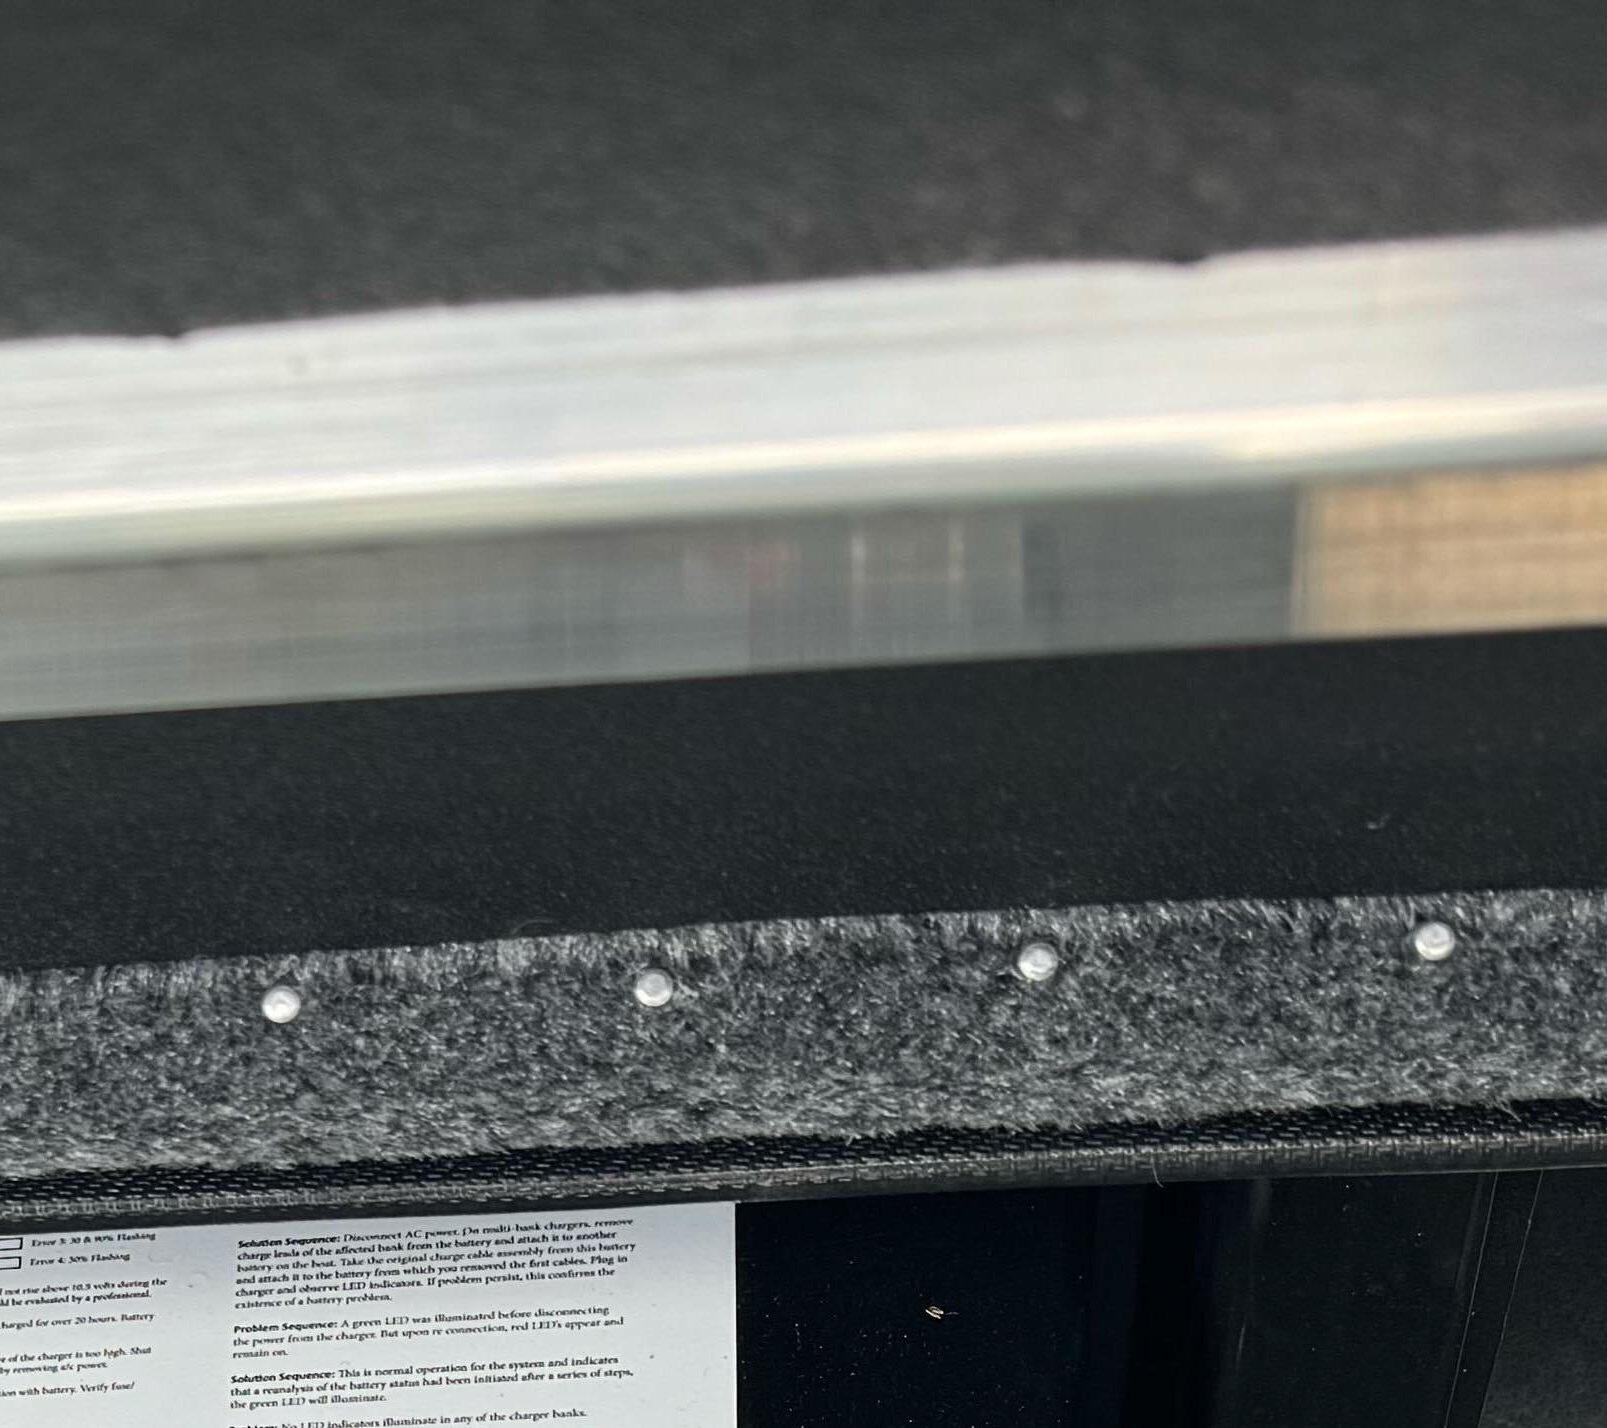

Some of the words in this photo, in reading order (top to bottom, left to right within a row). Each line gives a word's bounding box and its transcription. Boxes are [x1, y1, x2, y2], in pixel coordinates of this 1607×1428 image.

[328, 1420, 380, 1428] indicators
[440, 1416, 451, 1424] in
[454, 1415, 471, 1425] any
[476, 1413, 486, 1422] of
[490, 1413, 506, 1421] the
[509, 1411, 549, 1422] charger
